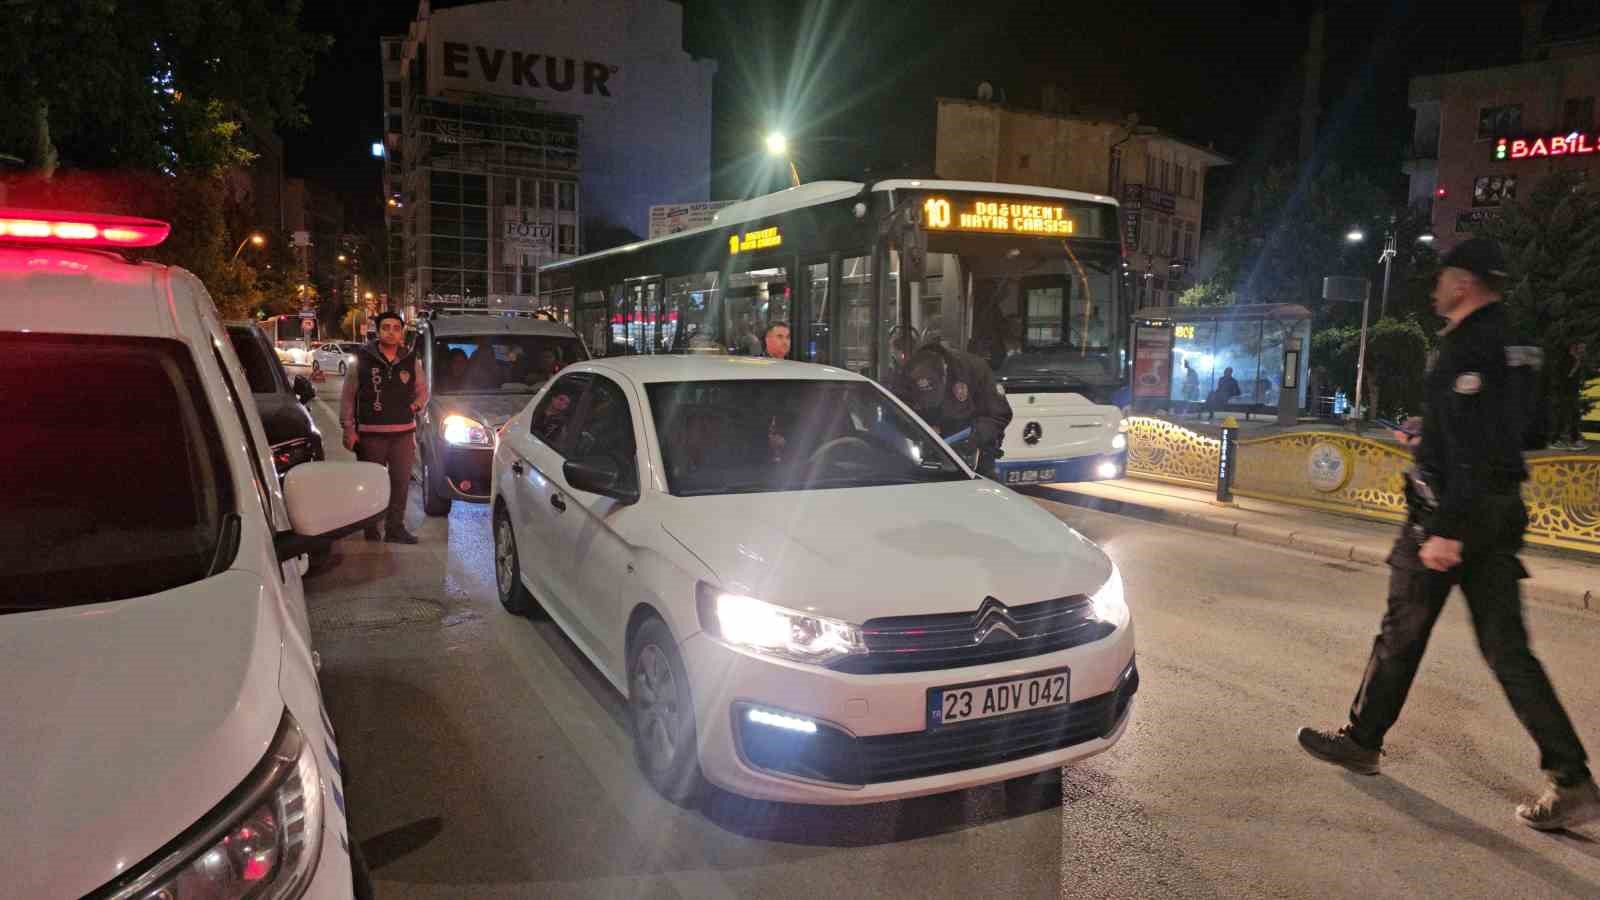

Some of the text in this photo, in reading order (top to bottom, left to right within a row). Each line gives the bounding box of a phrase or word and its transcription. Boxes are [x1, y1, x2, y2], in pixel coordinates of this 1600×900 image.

[443, 42, 611, 96] EVKUR
[924, 198, 951, 228] 10
[945, 691, 972, 720] 23
[982, 683, 1023, 714] ADV
[1028, 677, 1065, 706] 042
